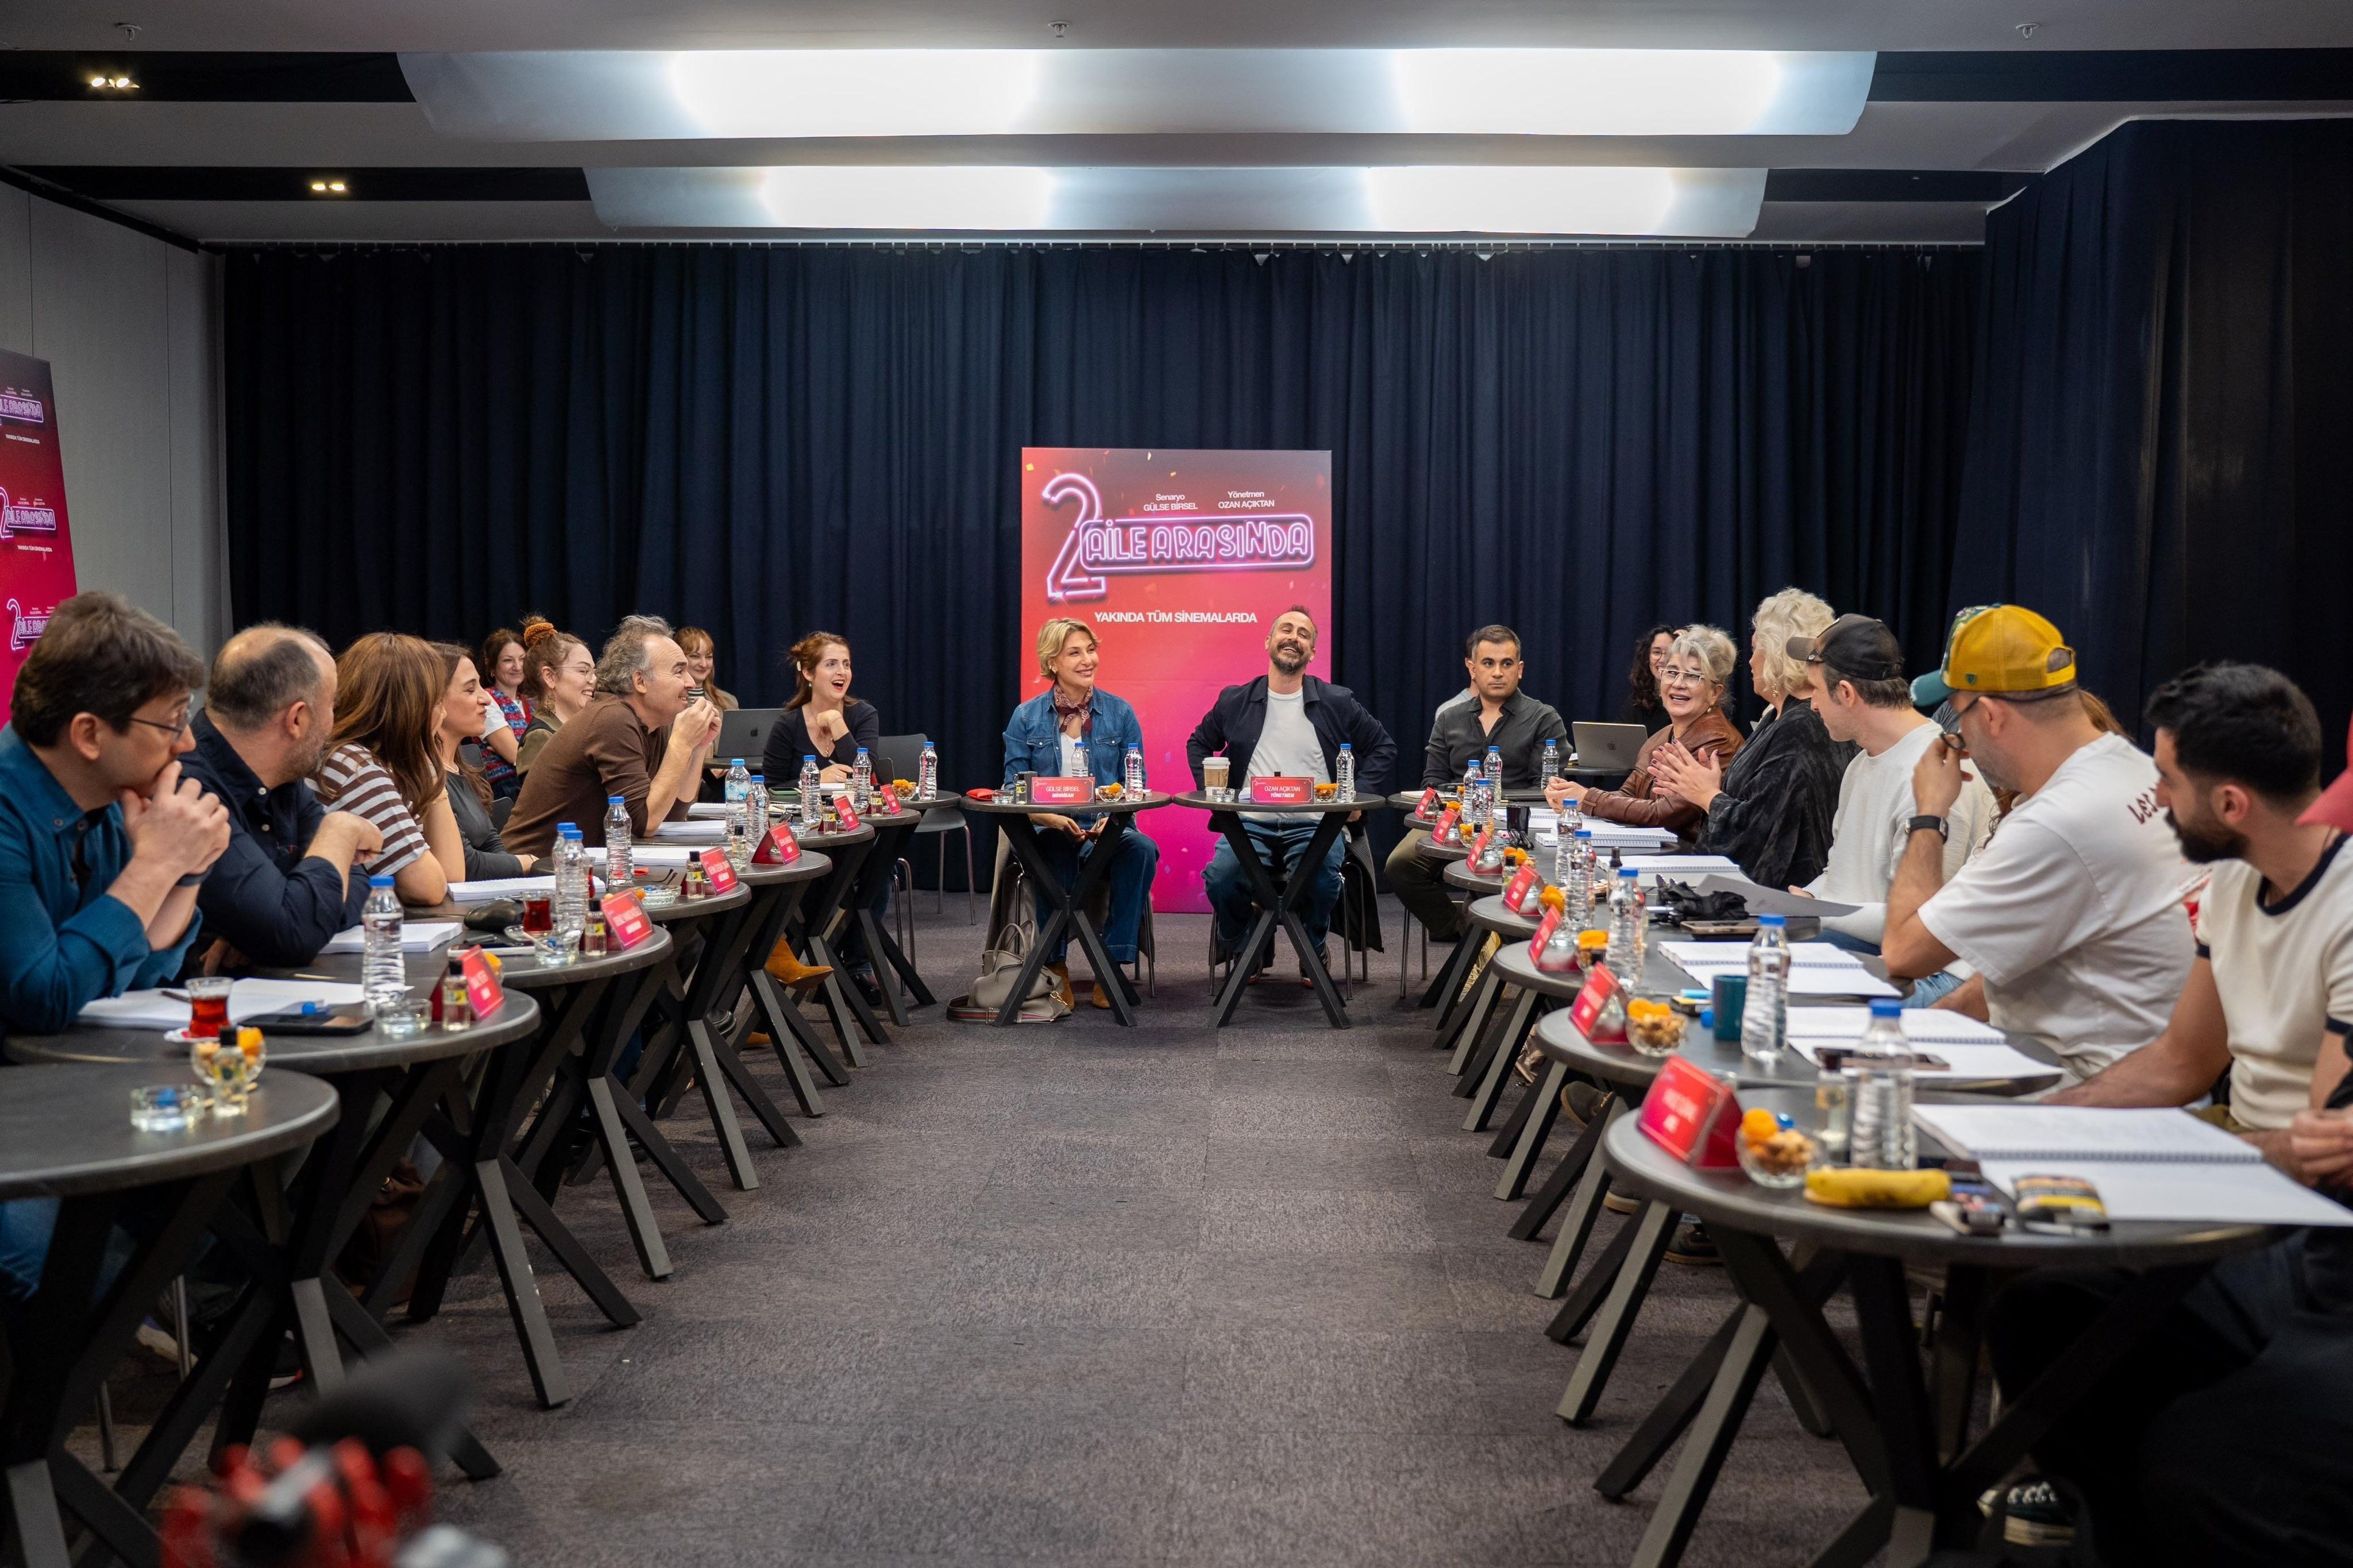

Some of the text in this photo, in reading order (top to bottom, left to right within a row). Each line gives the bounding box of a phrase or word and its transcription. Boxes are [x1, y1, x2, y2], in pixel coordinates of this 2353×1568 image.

[1155, 493, 1185, 502] Senaryo
[1143, 501, 1198, 511] GÜLSE BİRSEL
[1218, 499, 1275, 509] OZAN AÇIKTAN
[1042, 473, 1308, 598] 2 AİLE ARASINDA
[1094, 609, 1258, 623] YAKINDA TÜM SİNEMALARDA
[6, 598, 25, 651] 2
